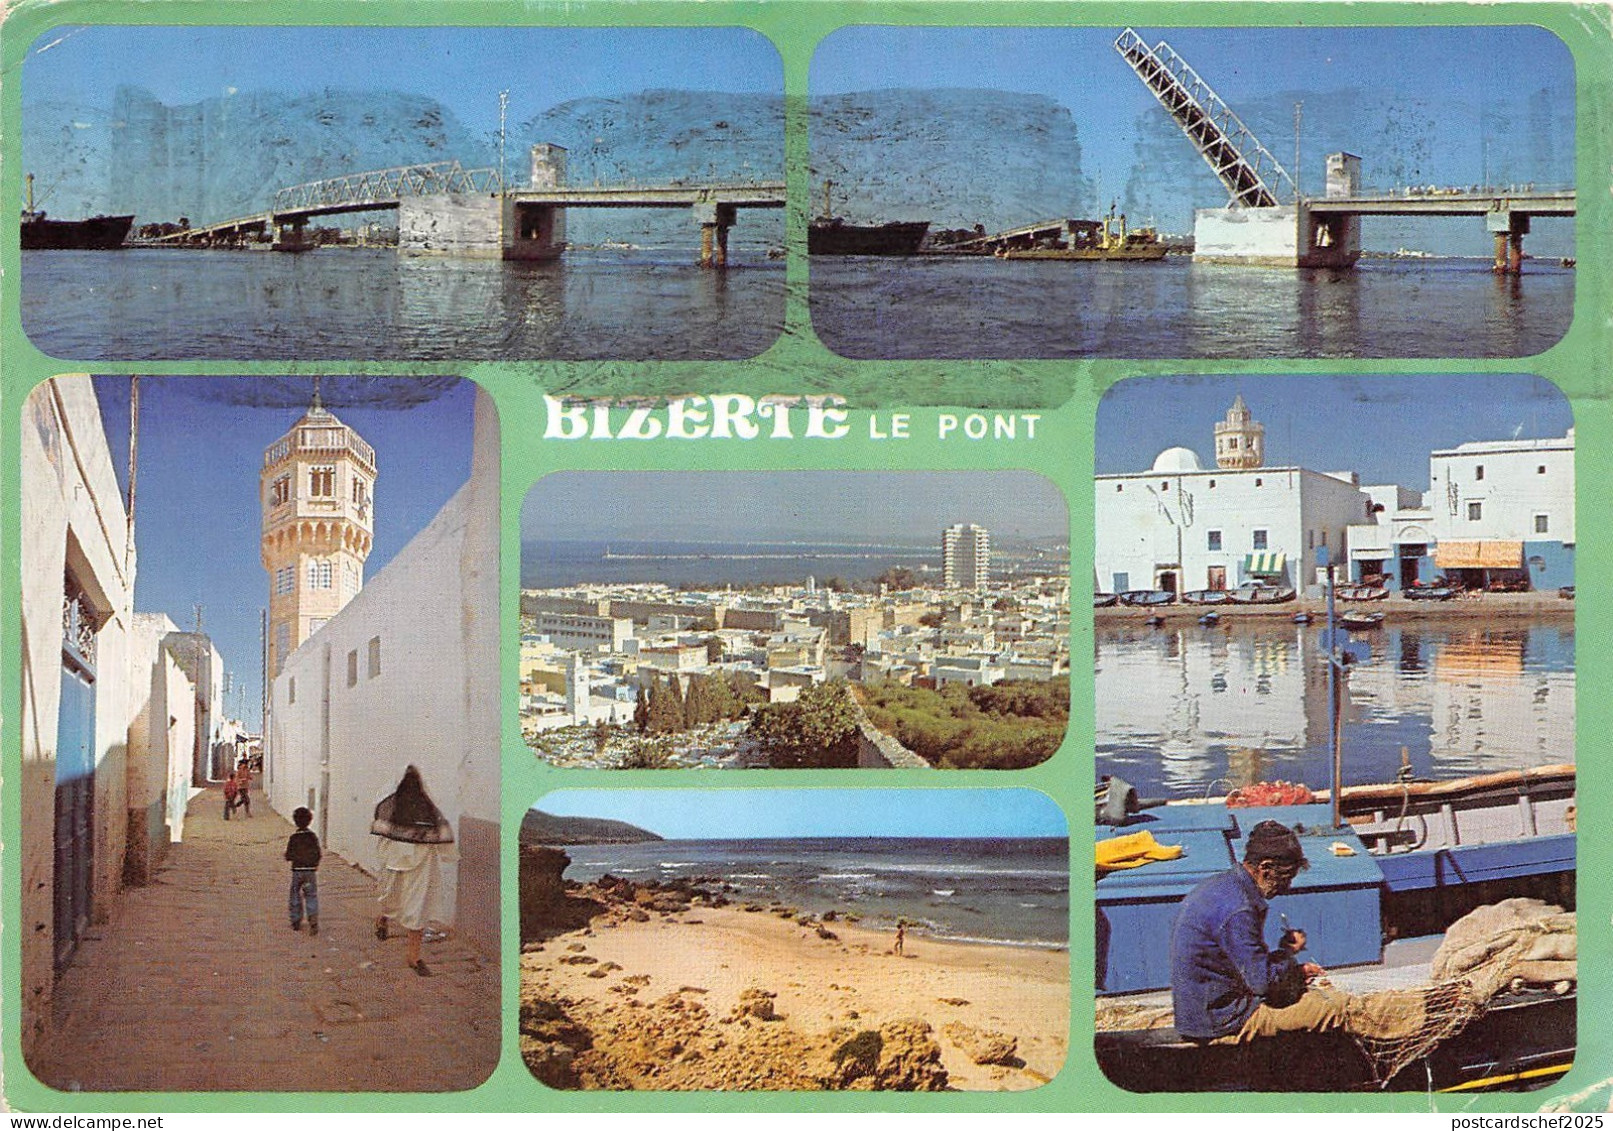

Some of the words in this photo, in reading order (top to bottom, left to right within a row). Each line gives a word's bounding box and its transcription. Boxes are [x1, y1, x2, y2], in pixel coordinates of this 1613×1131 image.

[542, 394, 849, 439] BIZERTE
[869, 414, 910, 438] LE
[938, 414, 1041, 439] PONT
